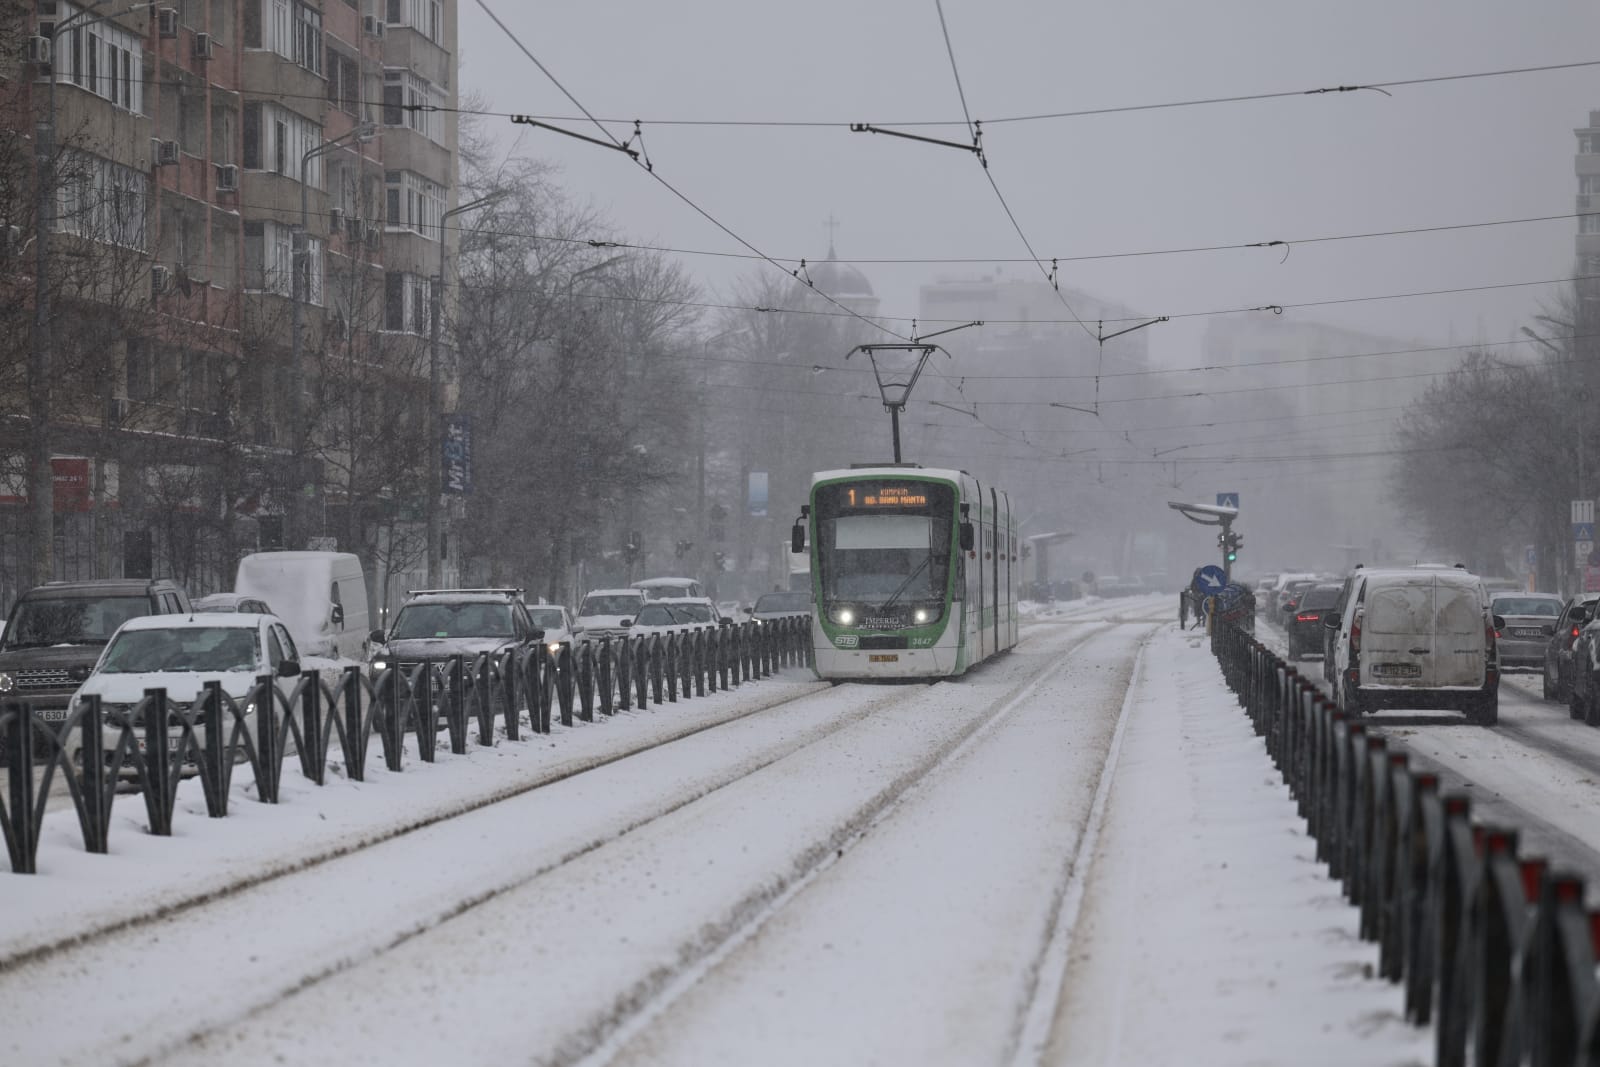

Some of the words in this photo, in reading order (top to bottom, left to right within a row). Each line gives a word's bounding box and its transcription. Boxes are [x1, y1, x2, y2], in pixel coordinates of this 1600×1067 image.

[848, 489, 856, 506] 1
[900, 496, 926, 505] MANTA
[835, 635, 858, 646] STB
[45, 711, 61, 720] 630
